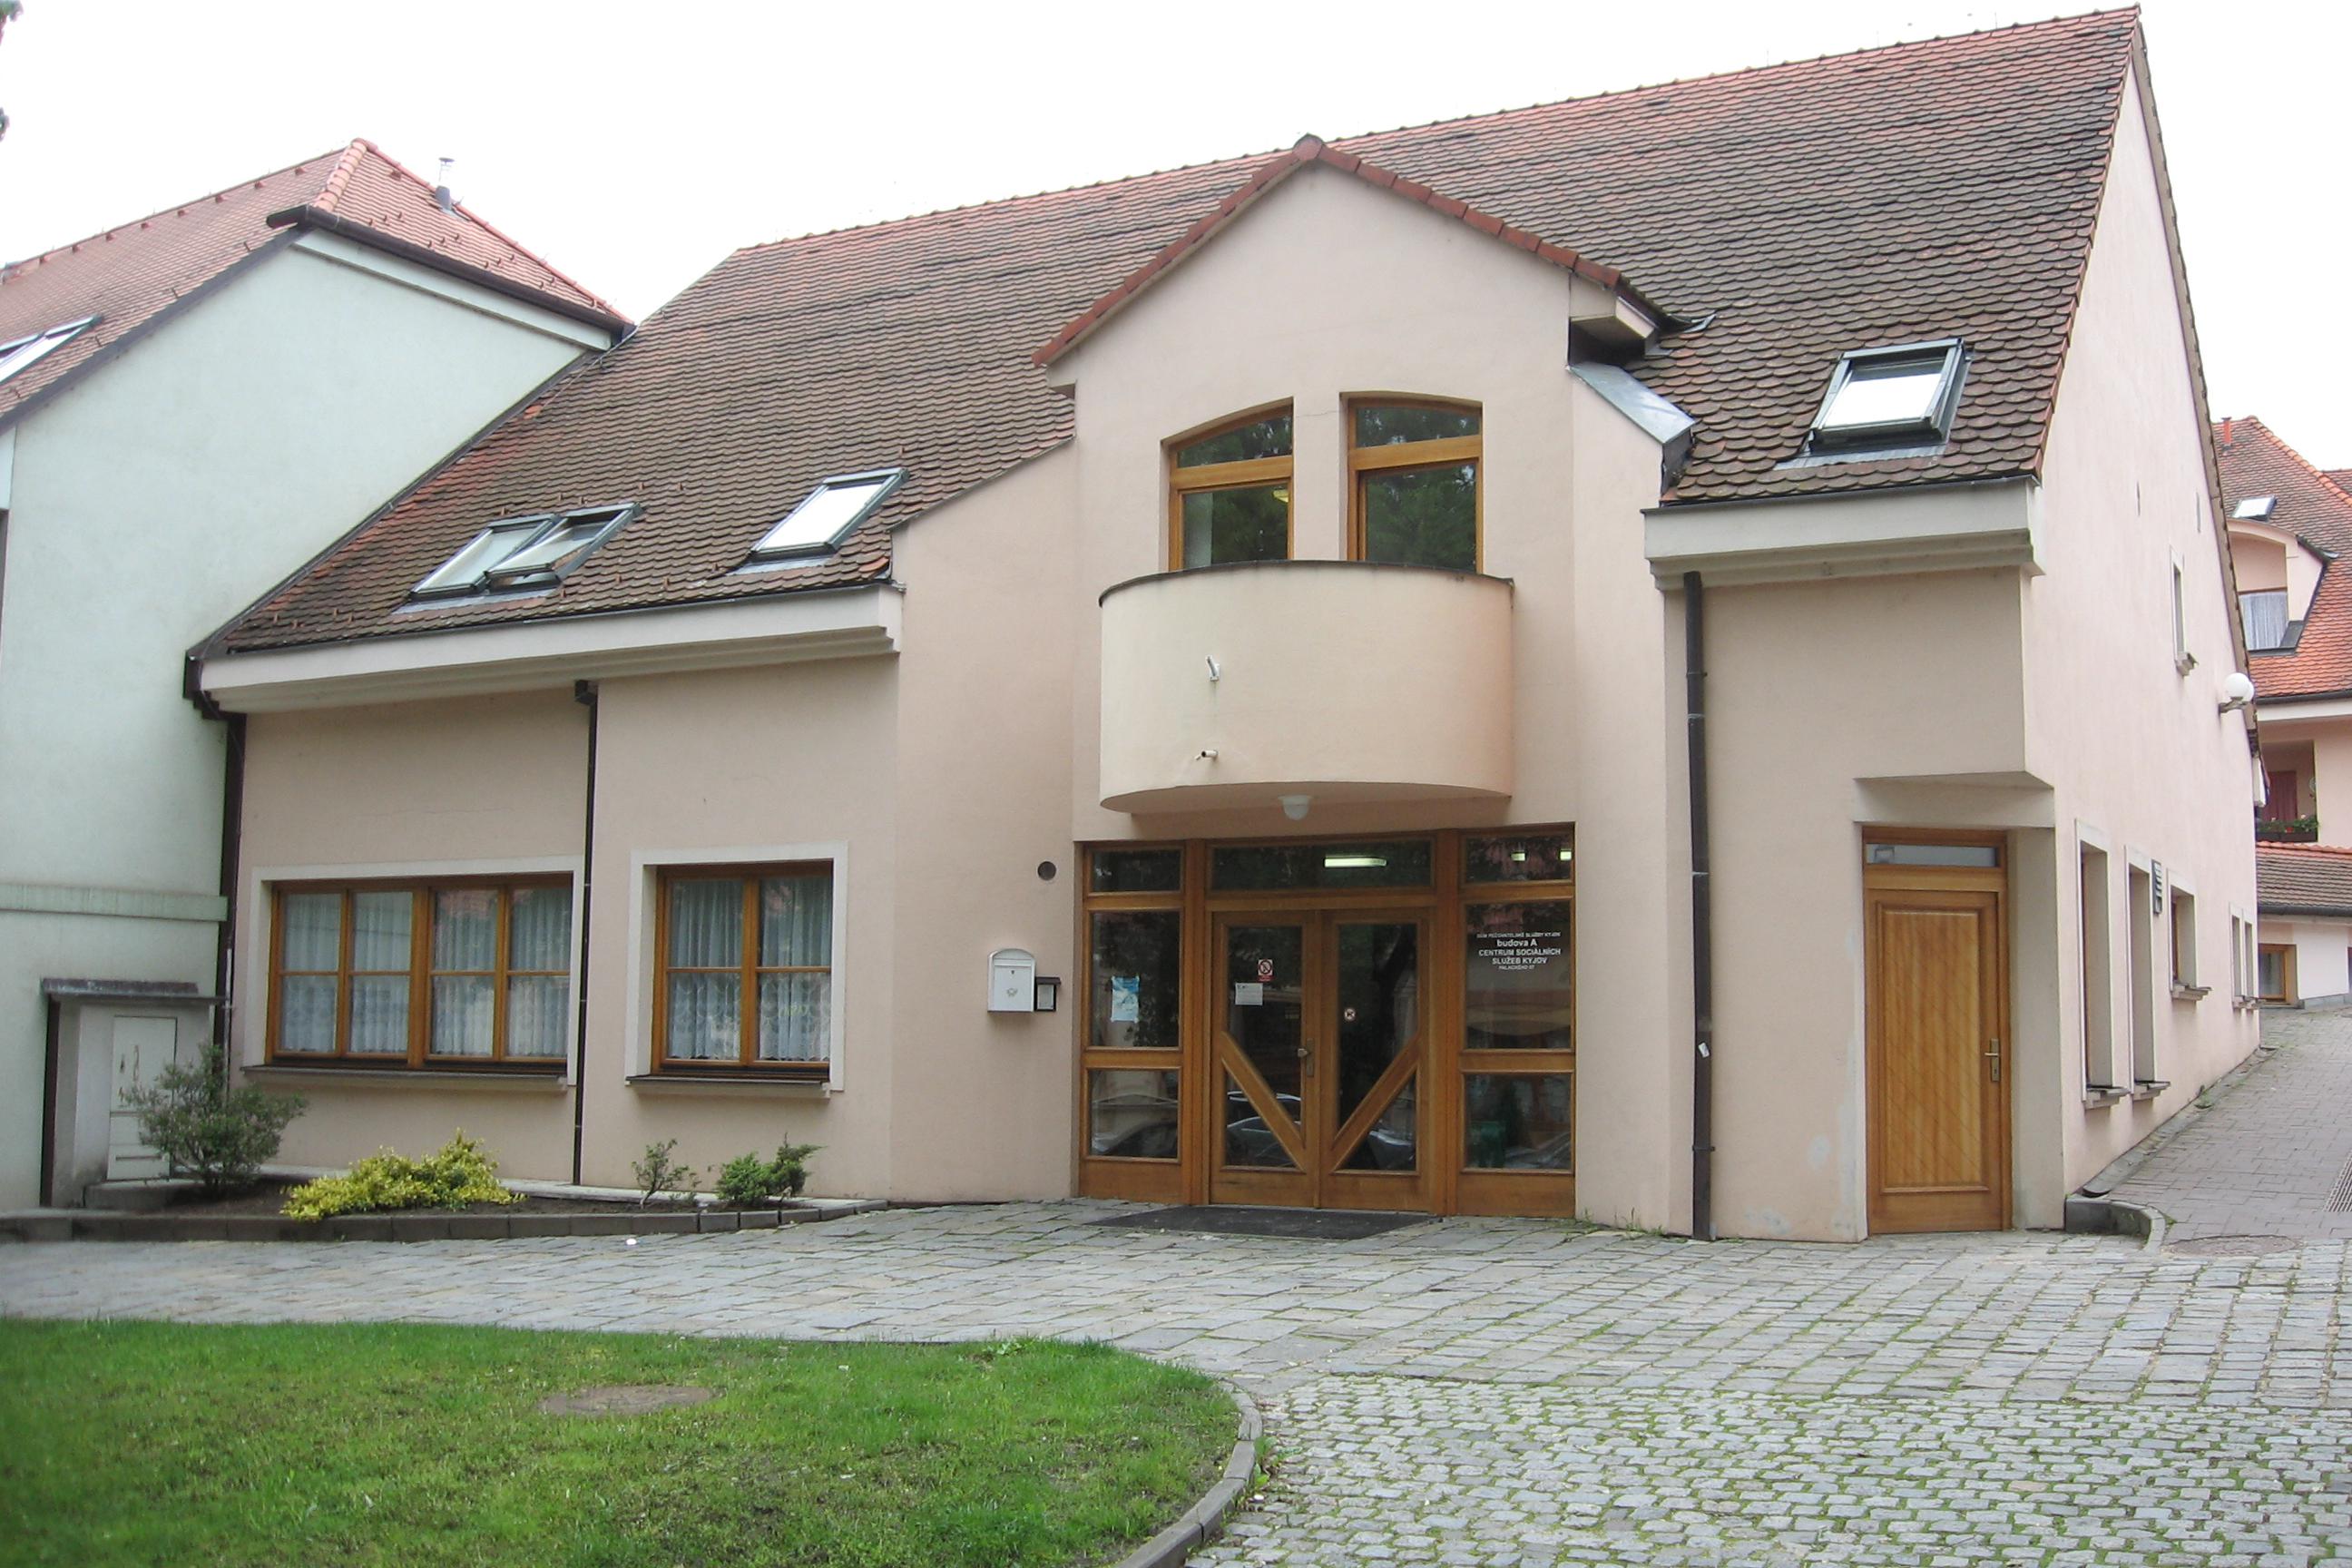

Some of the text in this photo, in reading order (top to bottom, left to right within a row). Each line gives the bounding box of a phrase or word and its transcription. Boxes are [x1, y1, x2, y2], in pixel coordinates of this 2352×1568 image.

[1531, 938, 1538, 946] A
[1516, 947, 1561, 956] SOCIÁLNÍCH
[1492, 956, 1521, 965] SLUŽEB
